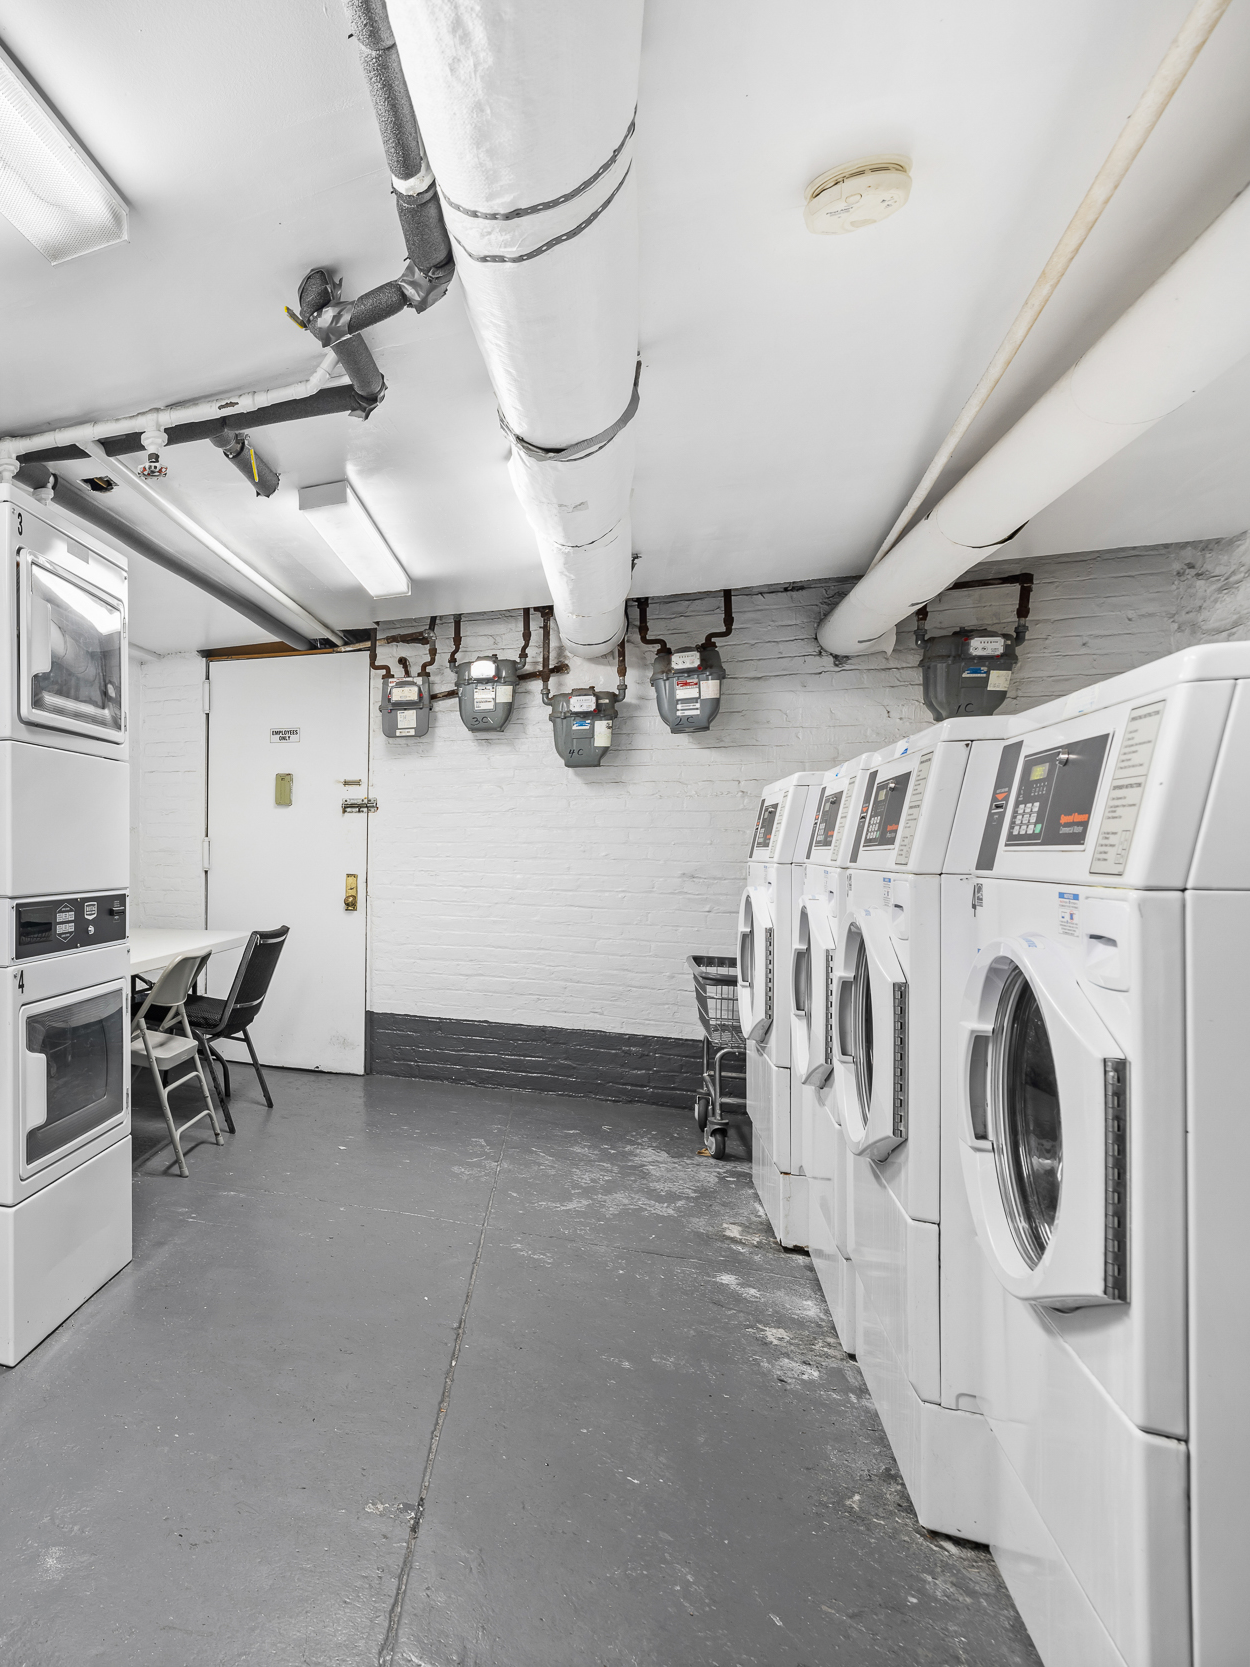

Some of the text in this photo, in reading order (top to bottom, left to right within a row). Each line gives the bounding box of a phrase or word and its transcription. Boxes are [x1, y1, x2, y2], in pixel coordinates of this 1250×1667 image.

[17, 512, 23, 536] 3
[1060, 813, 1089, 825] Speed Queen
[18, 970, 24, 994] 4
